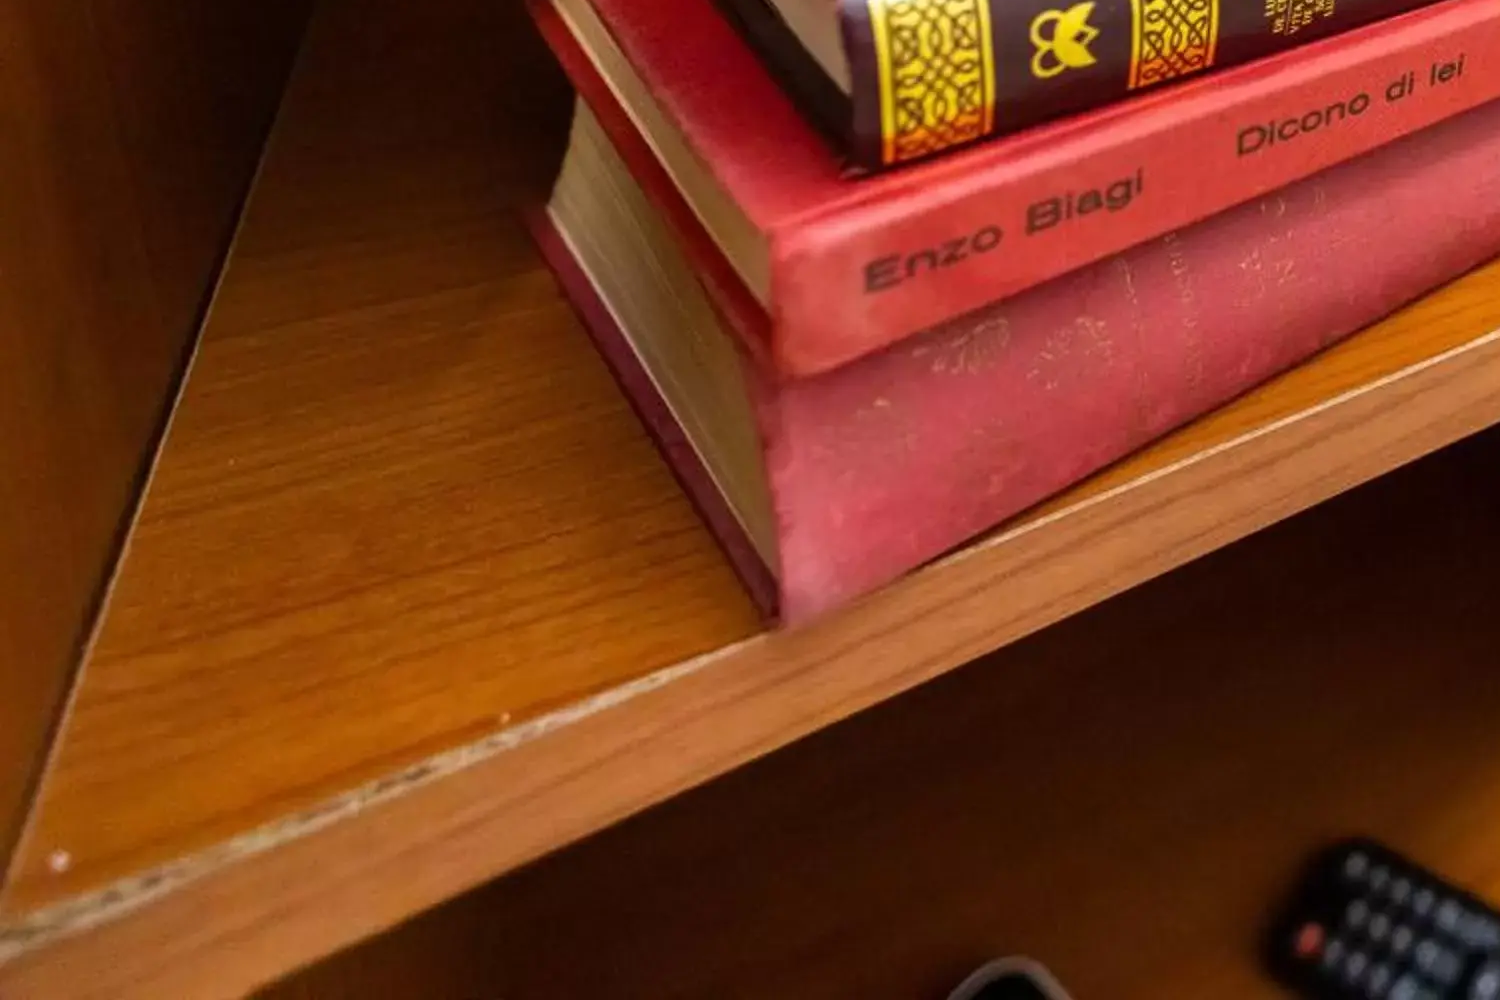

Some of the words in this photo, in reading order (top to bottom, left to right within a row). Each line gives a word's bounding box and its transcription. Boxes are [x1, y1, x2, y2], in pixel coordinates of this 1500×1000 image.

[1272, 18, 1285, 33] DE
[1288, 3, 1303, 34] VITA
[1301, 9, 1313, 26] DE
[1235, 92, 1371, 157] Dicono
[1385, 60, 1416, 103] di
[1429, 52, 1467, 86] lei
[863, 221, 1004, 295] Enzo
[1024, 166, 1145, 237] Biagi
